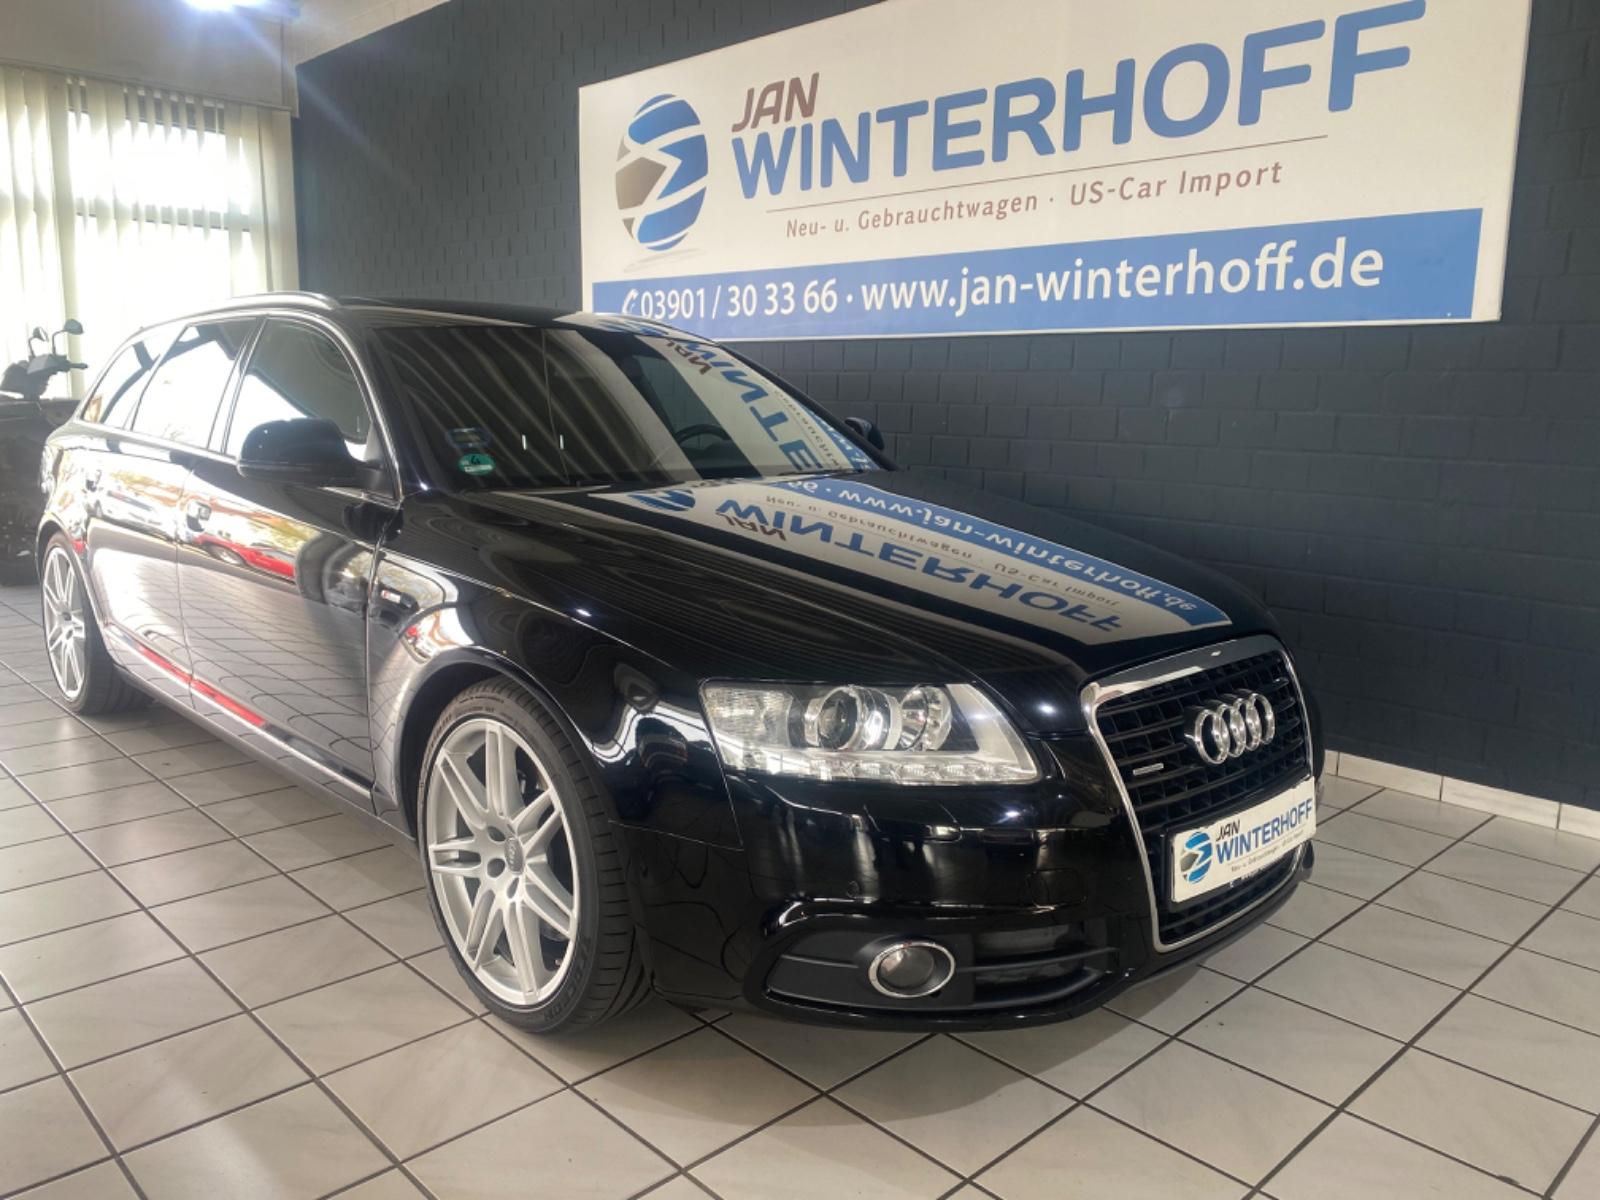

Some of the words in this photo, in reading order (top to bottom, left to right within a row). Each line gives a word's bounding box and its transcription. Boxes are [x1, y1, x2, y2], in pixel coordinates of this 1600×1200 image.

[731, 0, 1426, 199] WINTERHOFF
[731, 72, 820, 133] JAN
[786, 218, 826, 238] Neu-
[834, 217, 850, 233] u.
[857, 194, 1038, 230] Gebrauchtwagen
[1070, 175, 1167, 207] US-Car
[1179, 161, 1283, 199] Import
[861, 236, 1384, 317] www.jan-winterhoff.de
[1216, 819, 1241, 842] JAN
[1216, 798, 1313, 864] WINTERHOFF
